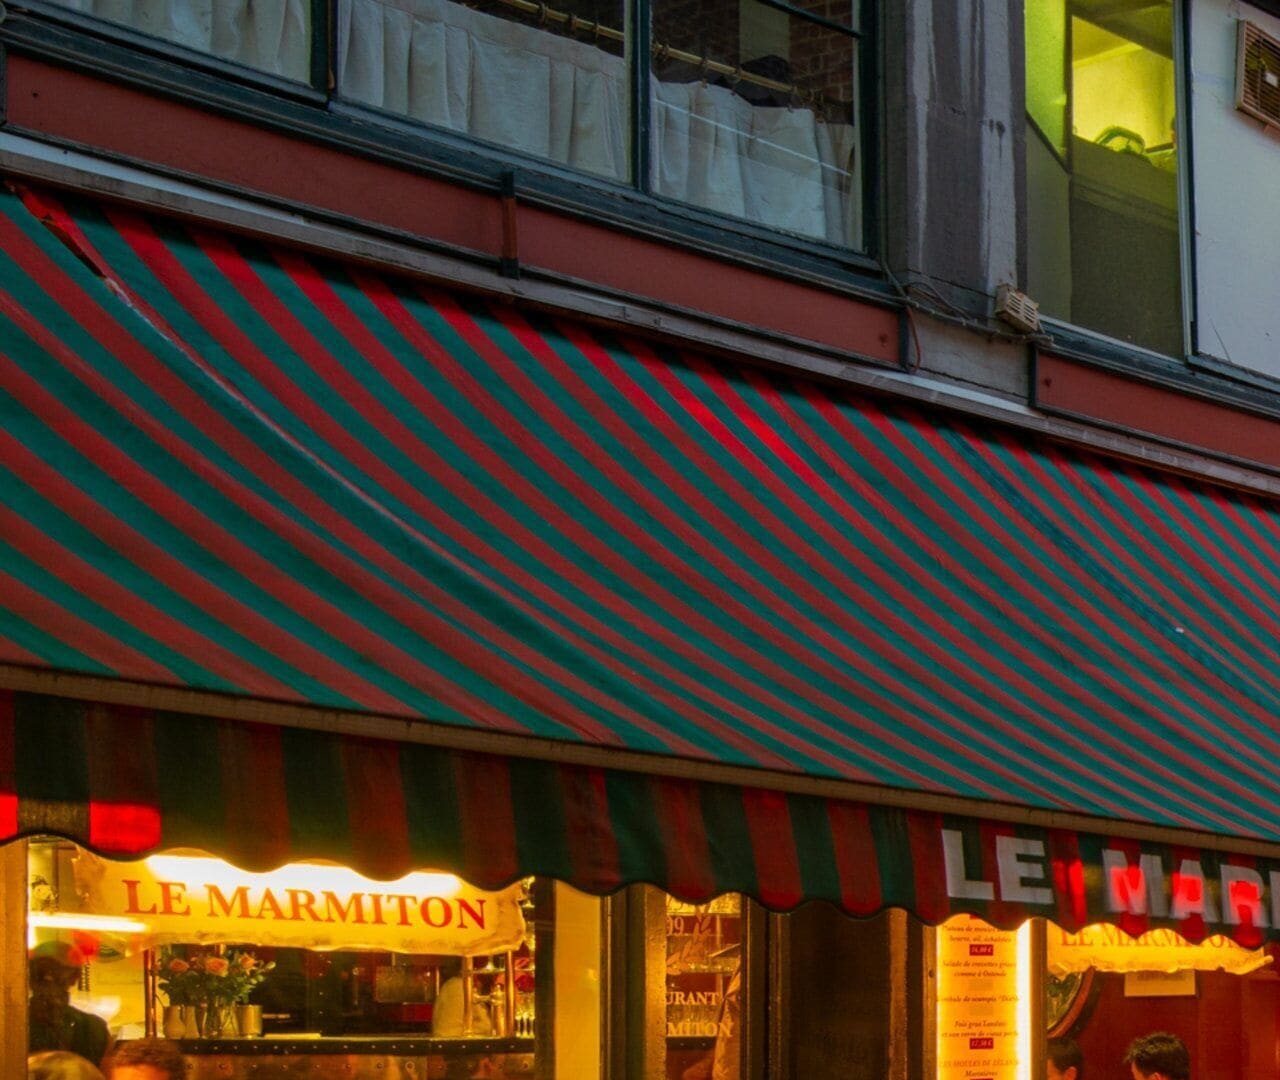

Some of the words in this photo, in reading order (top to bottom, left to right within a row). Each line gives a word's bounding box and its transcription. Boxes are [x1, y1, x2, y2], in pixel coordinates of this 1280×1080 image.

[941, 828, 1055, 905] LE
[122, 879, 192, 916] LE
[203, 883, 487, 931] MARMITON
